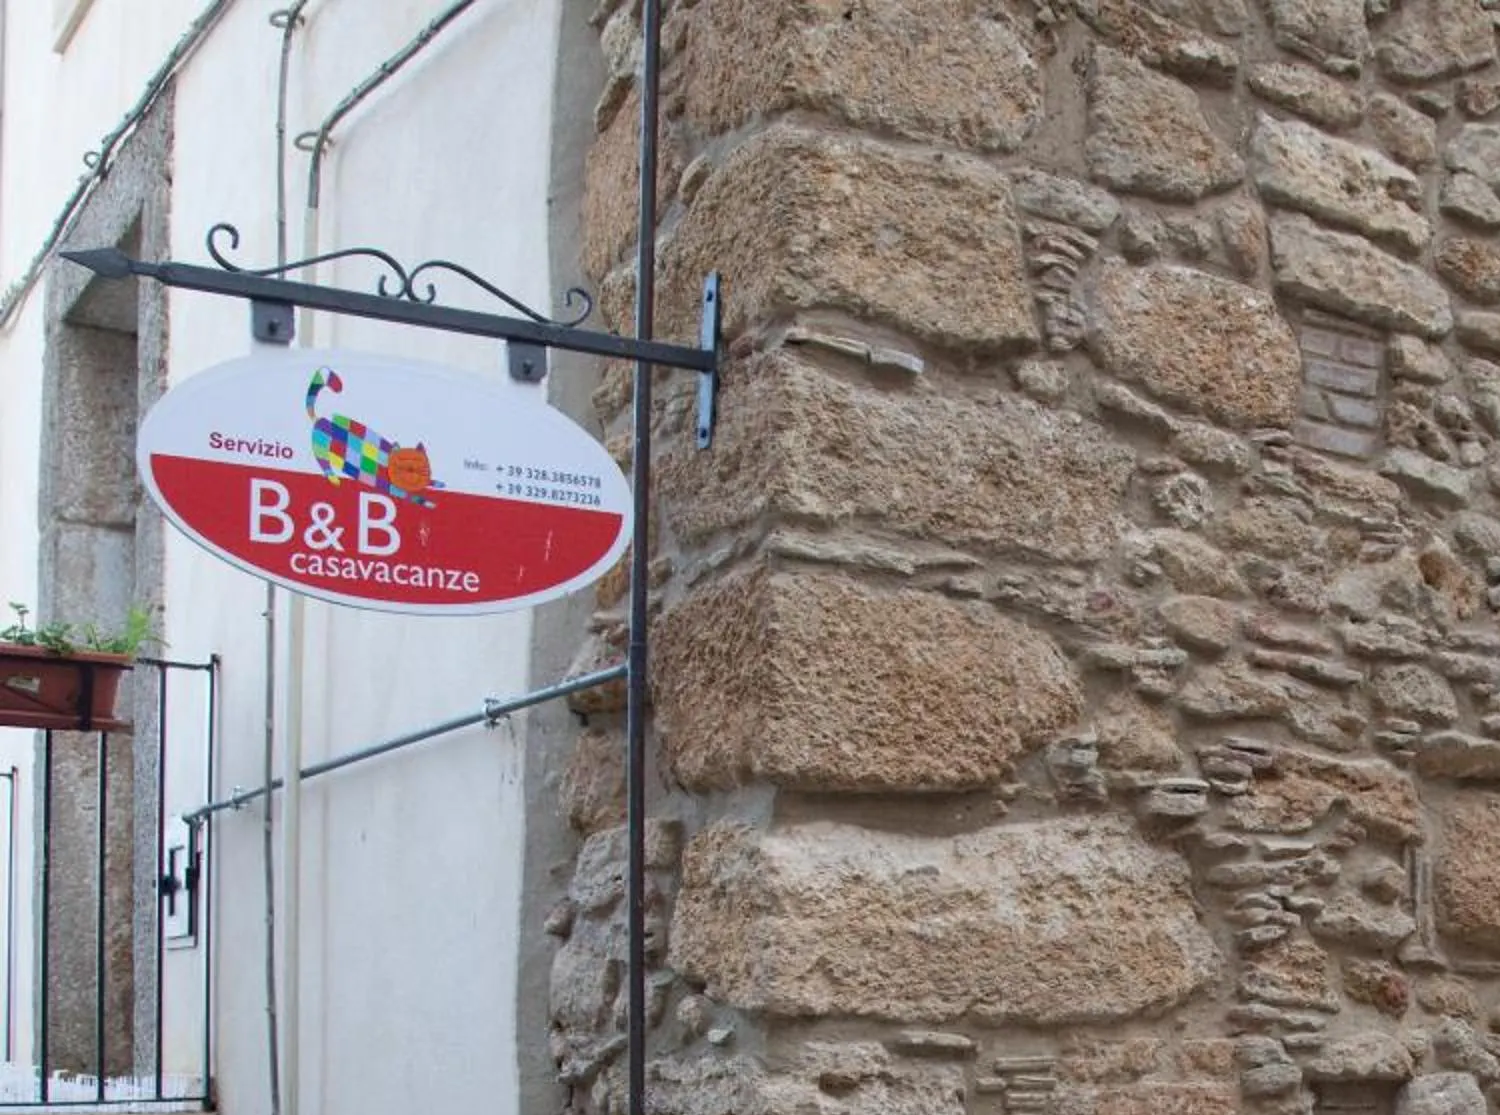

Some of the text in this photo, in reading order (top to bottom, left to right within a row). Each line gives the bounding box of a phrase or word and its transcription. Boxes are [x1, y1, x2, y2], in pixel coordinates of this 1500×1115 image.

[209, 431, 294, 461] Servizio
[508, 465, 522, 477] 39
[508, 483, 522, 495] 39
[290, 550, 481, 592] casavacanze
